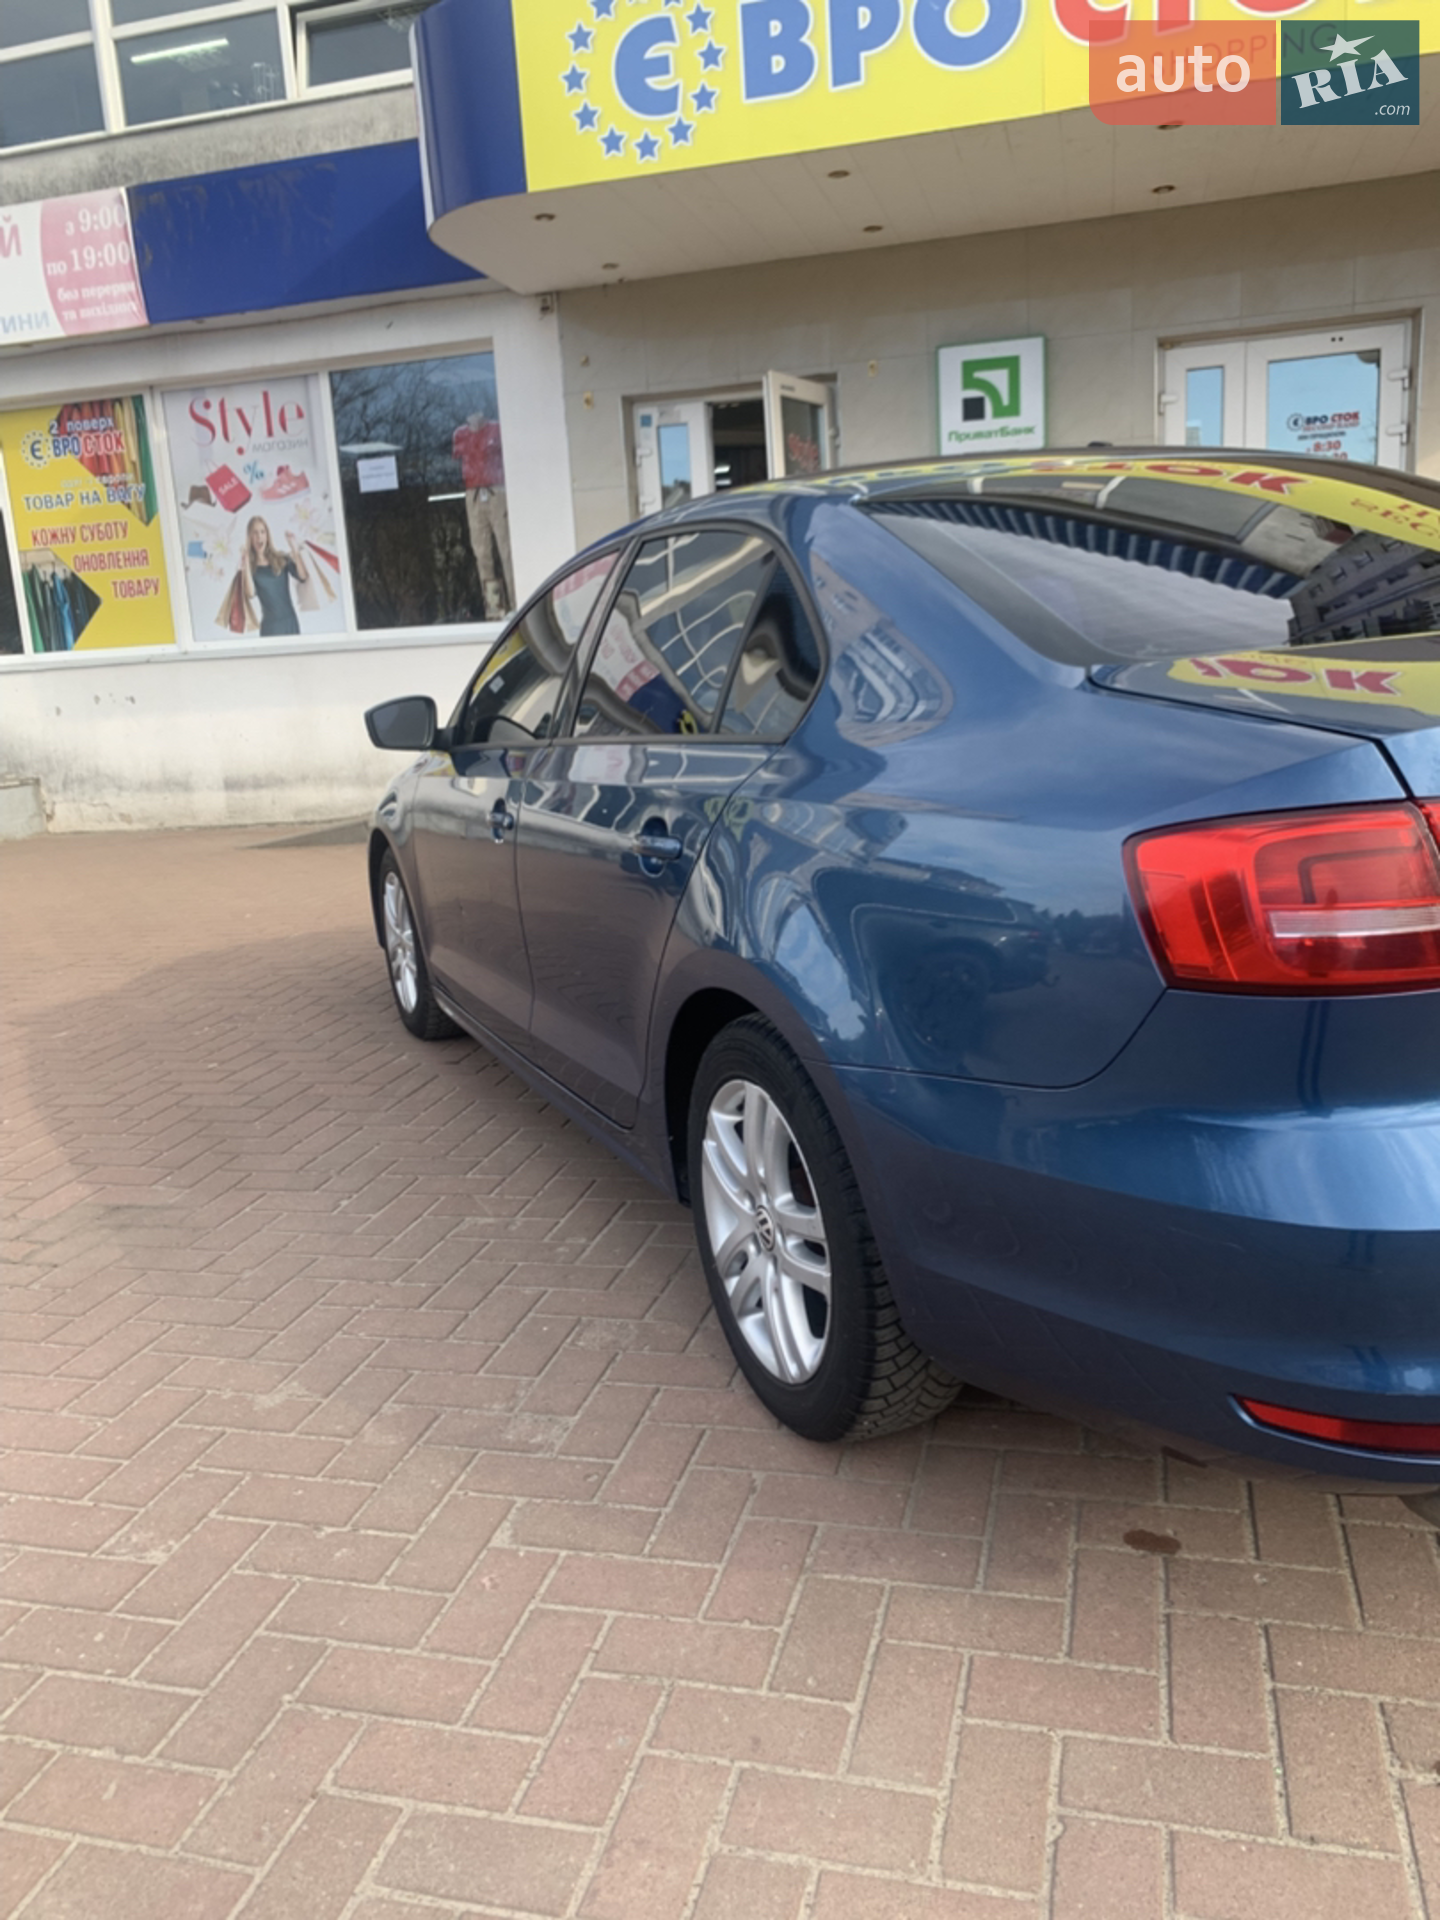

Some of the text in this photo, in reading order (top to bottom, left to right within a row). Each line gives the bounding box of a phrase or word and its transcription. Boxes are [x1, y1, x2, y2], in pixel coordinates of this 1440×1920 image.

[78, 205, 127, 233] 9:00
[46, 241, 131, 276] по 19:00
[49, 416, 114, 434] 2 поверх
[188, 390, 305, 456] Style
[948, 425, 1036, 443] ПриватБанк
[252, 438, 309, 454] магазин
[24, 484, 145, 511] ТОВАР НА ВАГУ
[218, 477, 239, 496] SALE
[31, 521, 128, 546] КОЖНУ СУБОТУ
[73, 549, 149, 573] ОНОВЛЕННЯ
[111, 578, 160, 598] ТОВАРУ
